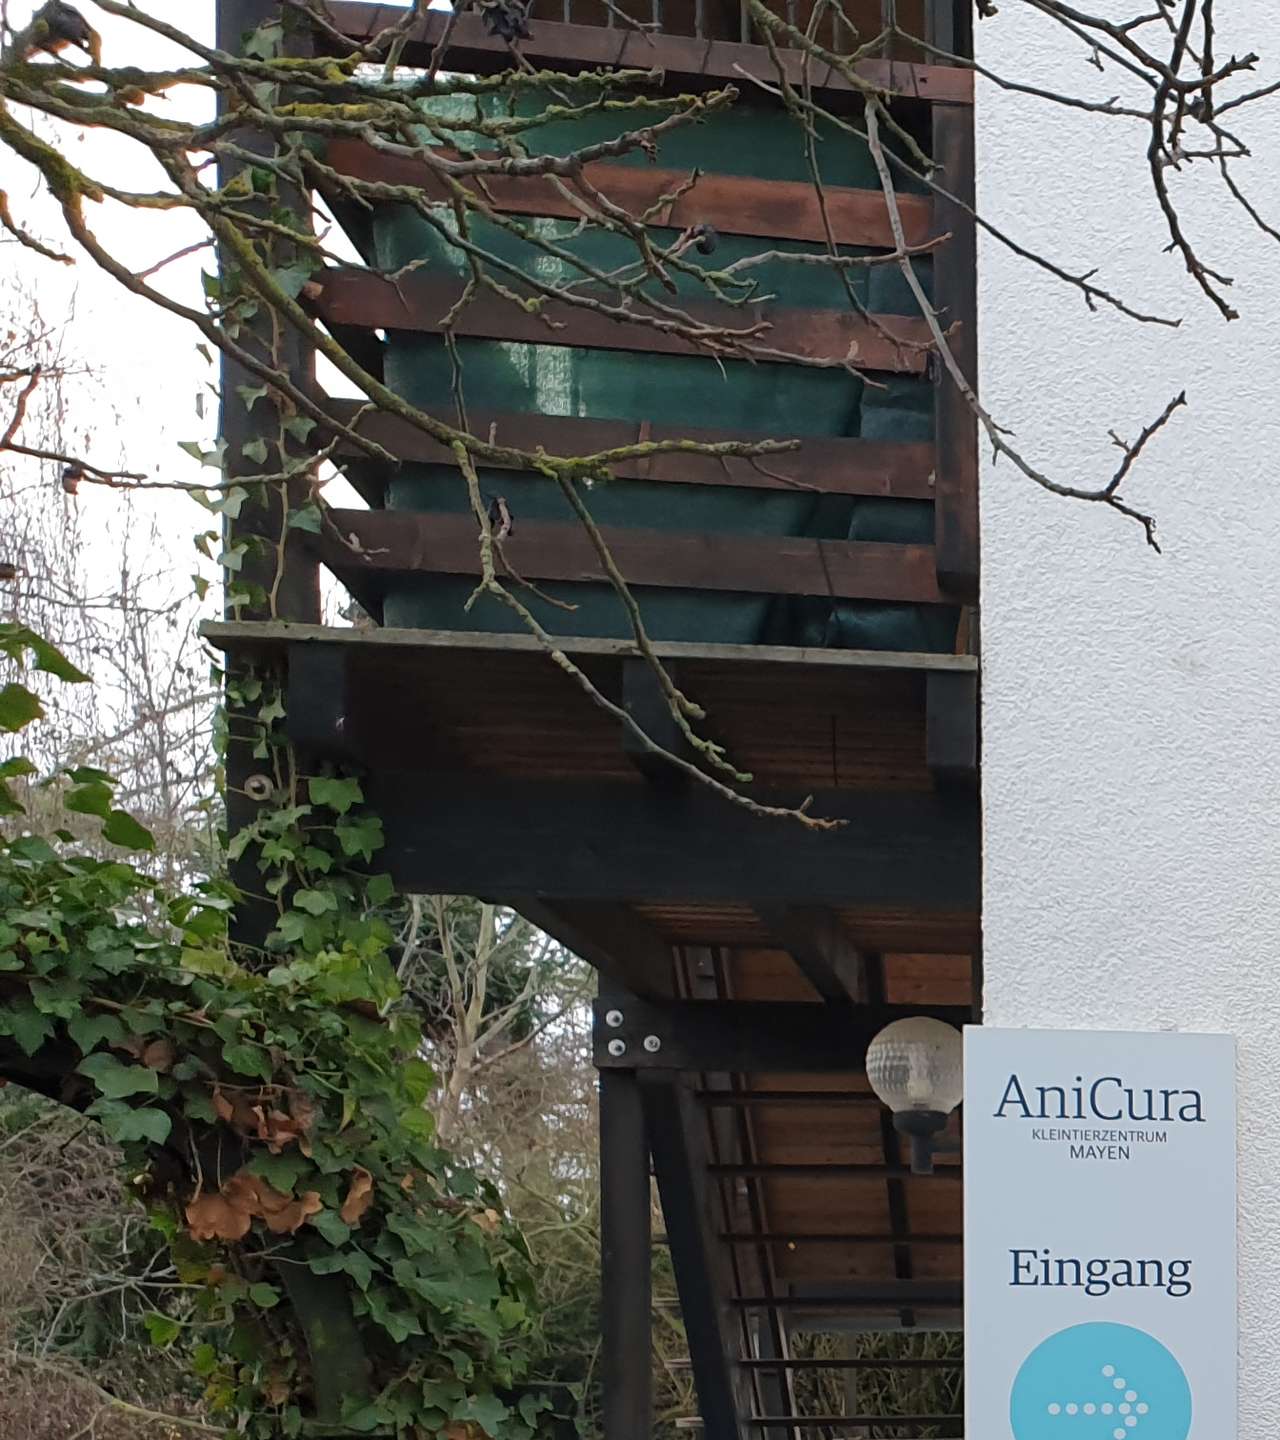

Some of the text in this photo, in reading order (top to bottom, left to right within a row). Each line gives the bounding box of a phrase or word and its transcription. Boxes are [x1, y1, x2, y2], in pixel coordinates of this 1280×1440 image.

[992, 1073, 1207, 1123] AniCura
[1031, 1128, 1168, 1144] KLEINTIERZENTRUM
[1069, 1144, 1131, 1161] MAYEN
[1008, 1248, 1193, 1297] Eingang
